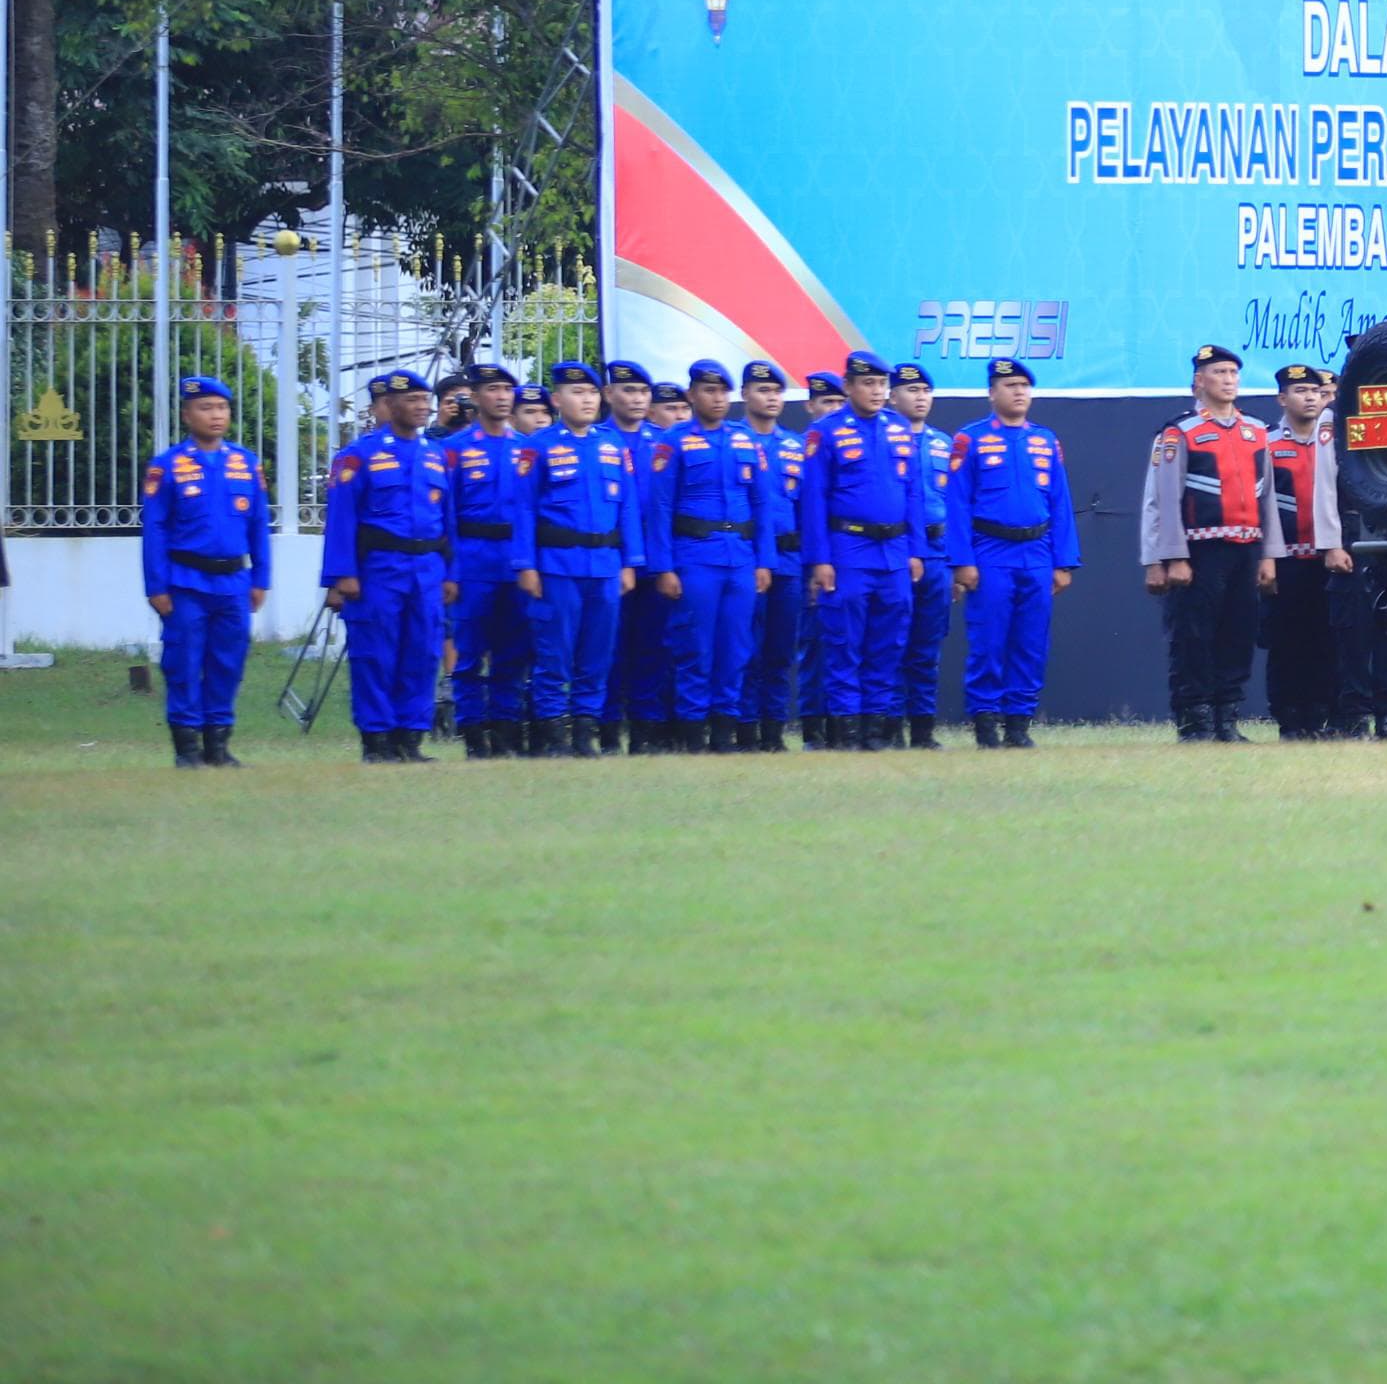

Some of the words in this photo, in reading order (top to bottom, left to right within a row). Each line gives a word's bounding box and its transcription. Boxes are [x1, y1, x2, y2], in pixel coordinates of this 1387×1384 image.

[1067, 101, 1297, 184] PELAYANAN
[913, 300, 1070, 360] PRESISI
[1242, 290, 1328, 364] Mudik
